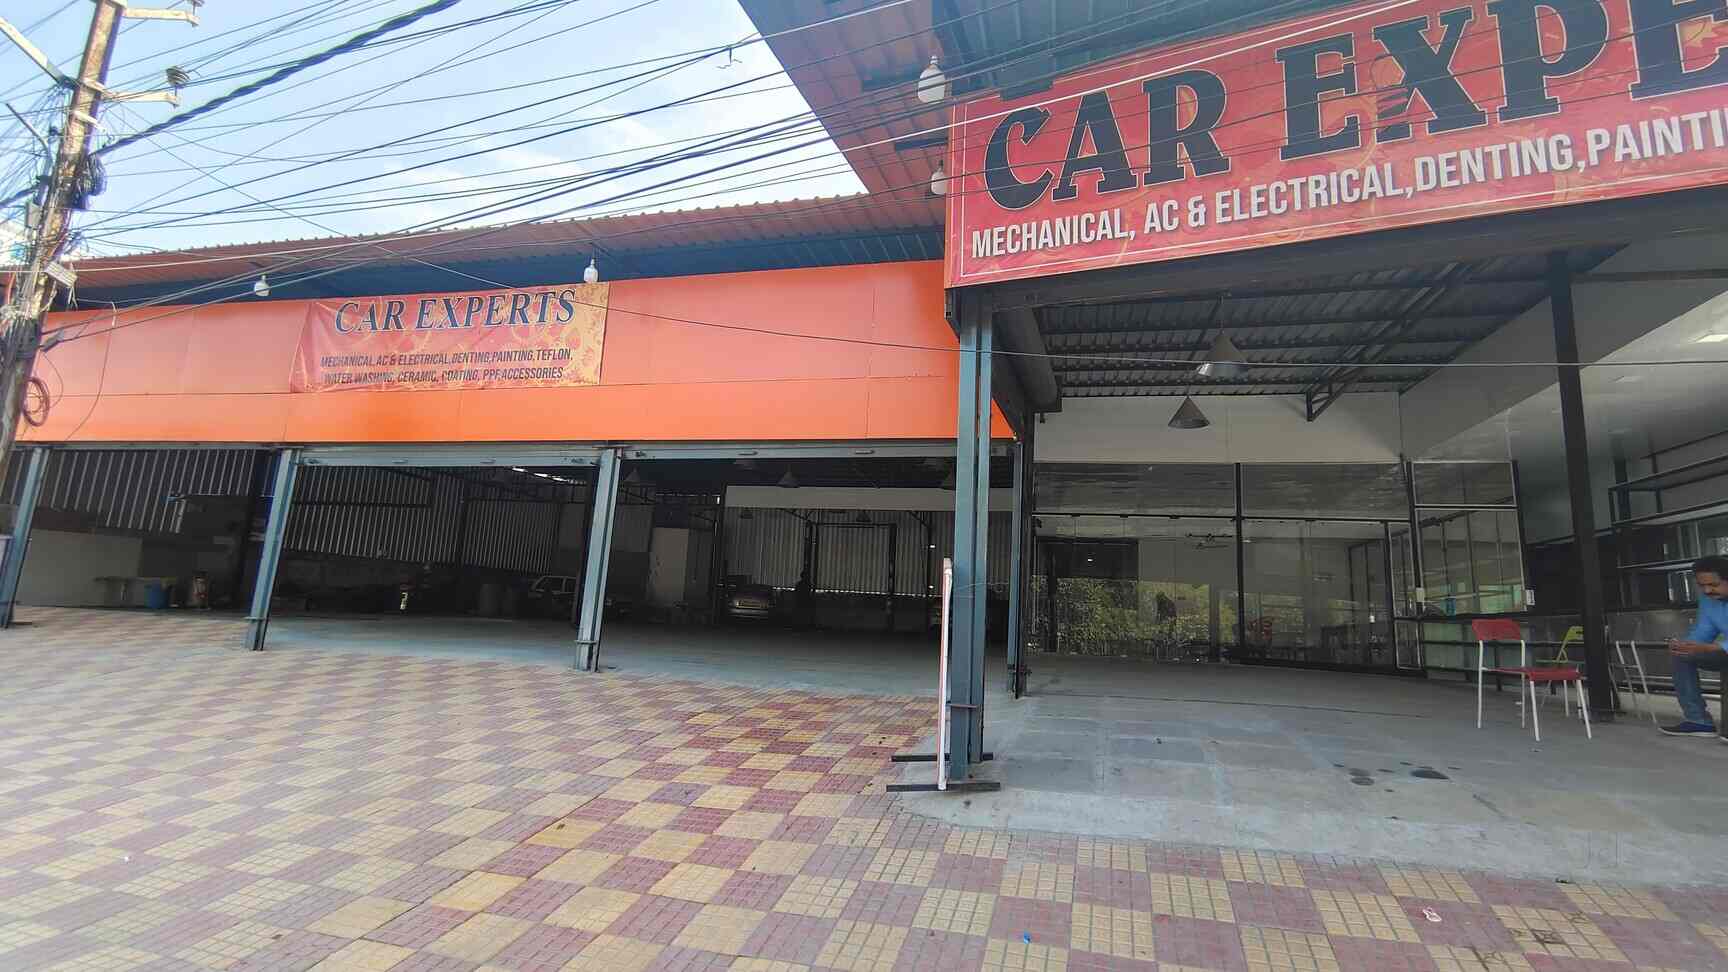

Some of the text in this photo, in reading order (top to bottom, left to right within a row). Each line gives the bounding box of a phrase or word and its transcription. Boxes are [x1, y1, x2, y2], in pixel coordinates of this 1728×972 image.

[984, 66, 1230, 210] CAR
[971, 208, 1136, 258] MECHANICAL,
[1143, 199, 1179, 234] AC
[1187, 195, 1207, 227] &
[335, 288, 577, 334] CAR EXPERTS
